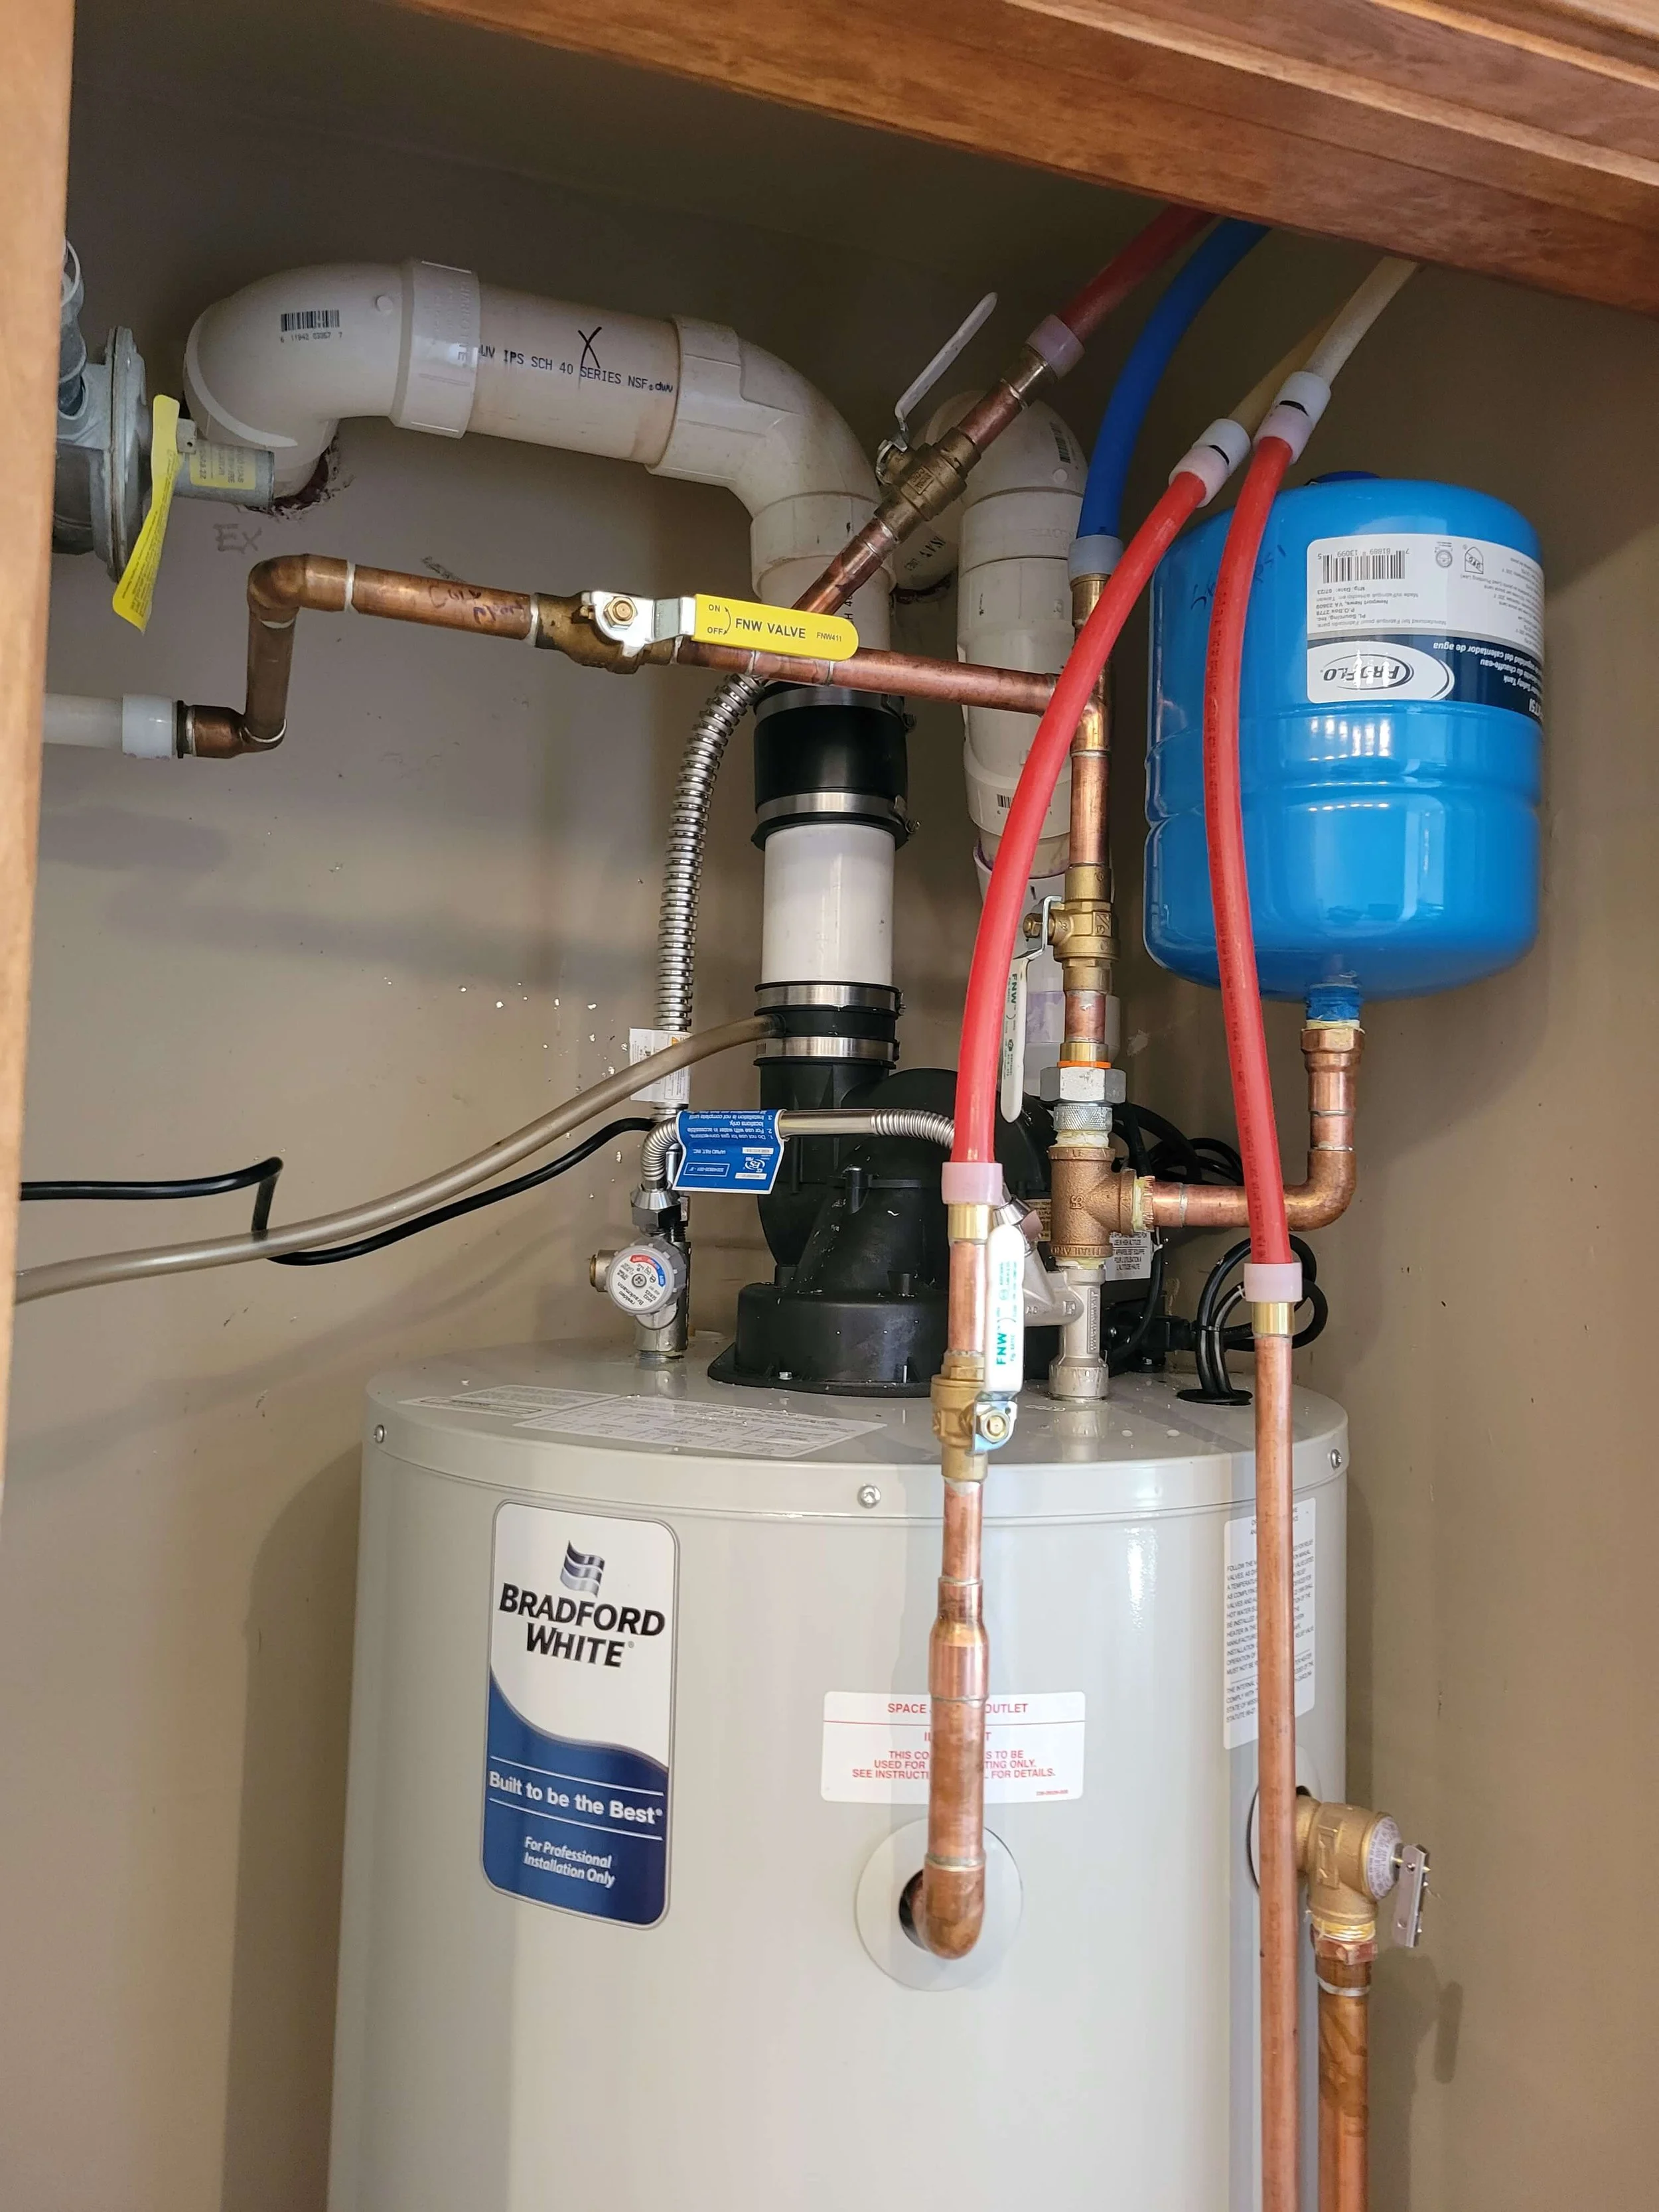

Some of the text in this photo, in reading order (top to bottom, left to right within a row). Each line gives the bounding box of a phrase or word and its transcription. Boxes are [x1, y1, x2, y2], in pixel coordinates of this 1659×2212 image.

[503, 349, 524, 365] IPS
[531, 356, 553, 371] SCH
[559, 362, 573, 374] 40
[580, 366, 622, 385] SERIES
[707, 604, 721, 613] ON
[707, 627, 723, 635] OFF
[735, 618, 843, 642] FNW VALVE FNW411
[1433, 641, 1455, 651] agua
[1455, 644, 1466, 654] de
[1466, 644, 1504, 660] calentador
[995, 1332, 1007, 1365] FNW
[498, 1582, 666, 1637] BRADFORD
[526, 1622, 626, 1668] WHITE
[887, 1703, 927, 1714] SPACE
[889, 1751, 912, 1760] THIS
[995, 1751, 1007, 1759] TO
[1009, 1750, 1024, 1759] BE
[874, 1760, 926, 1769] USED FOR
[1010, 1759, 1037, 1769] ONLY.
[852, 1769, 929, 1779] SEE INSTRUCTI
[991, 1768, 1056, 1779] FOR DETAILS.
[489, 1769, 523, 1795] Built
[525, 1780, 543, 1801] to
[547, 1786, 570, 1808] be
[575, 1793, 605, 1815] the
[524, 1836, 613, 1869] For Professional
[523, 1851, 616, 1889] Installation Only
